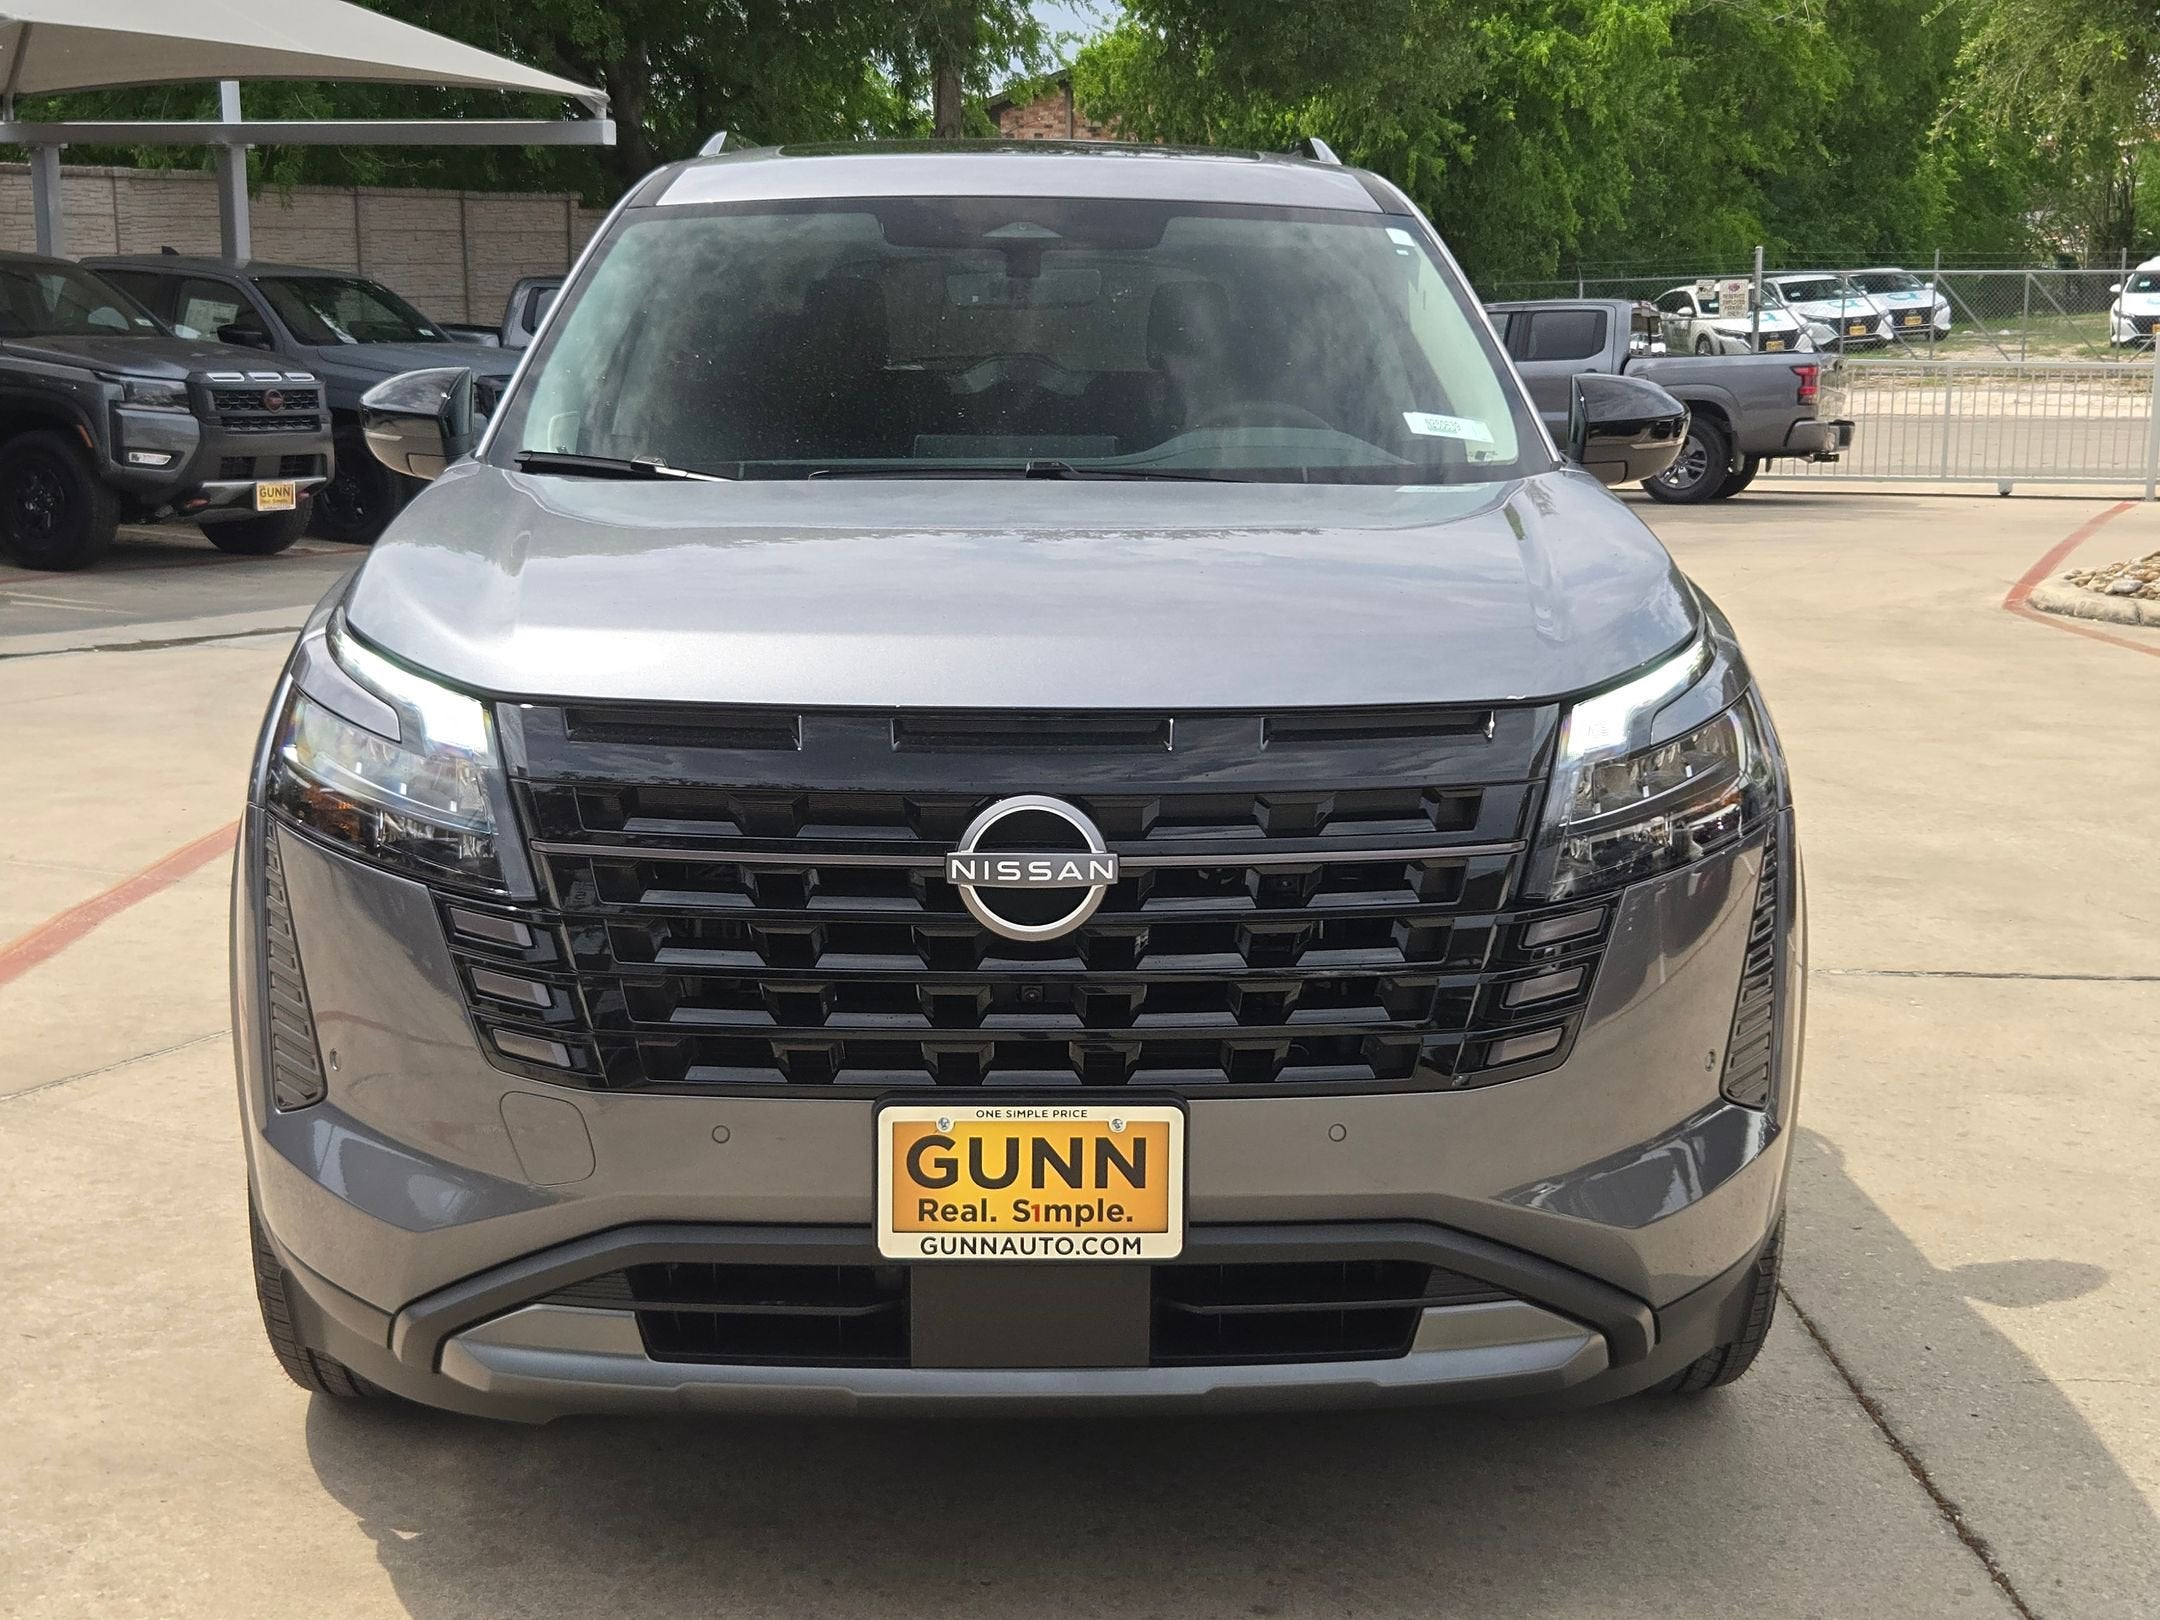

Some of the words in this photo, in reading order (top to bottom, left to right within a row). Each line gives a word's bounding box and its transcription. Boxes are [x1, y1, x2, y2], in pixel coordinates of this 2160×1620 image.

[259, 486, 291, 498] GUNN
[951, 859, 1113, 881] NISSAN
[976, 1109, 1002, 1118] ONE
[1006, 1109, 1049, 1118] SIMPLE
[1052, 1109, 1088, 1118] PRICE
[906, 1135, 1147, 1190] GUNN
[918, 1198, 997, 1222] Real.
[920, 1236, 1142, 1256] GUNNAUTO.COM
